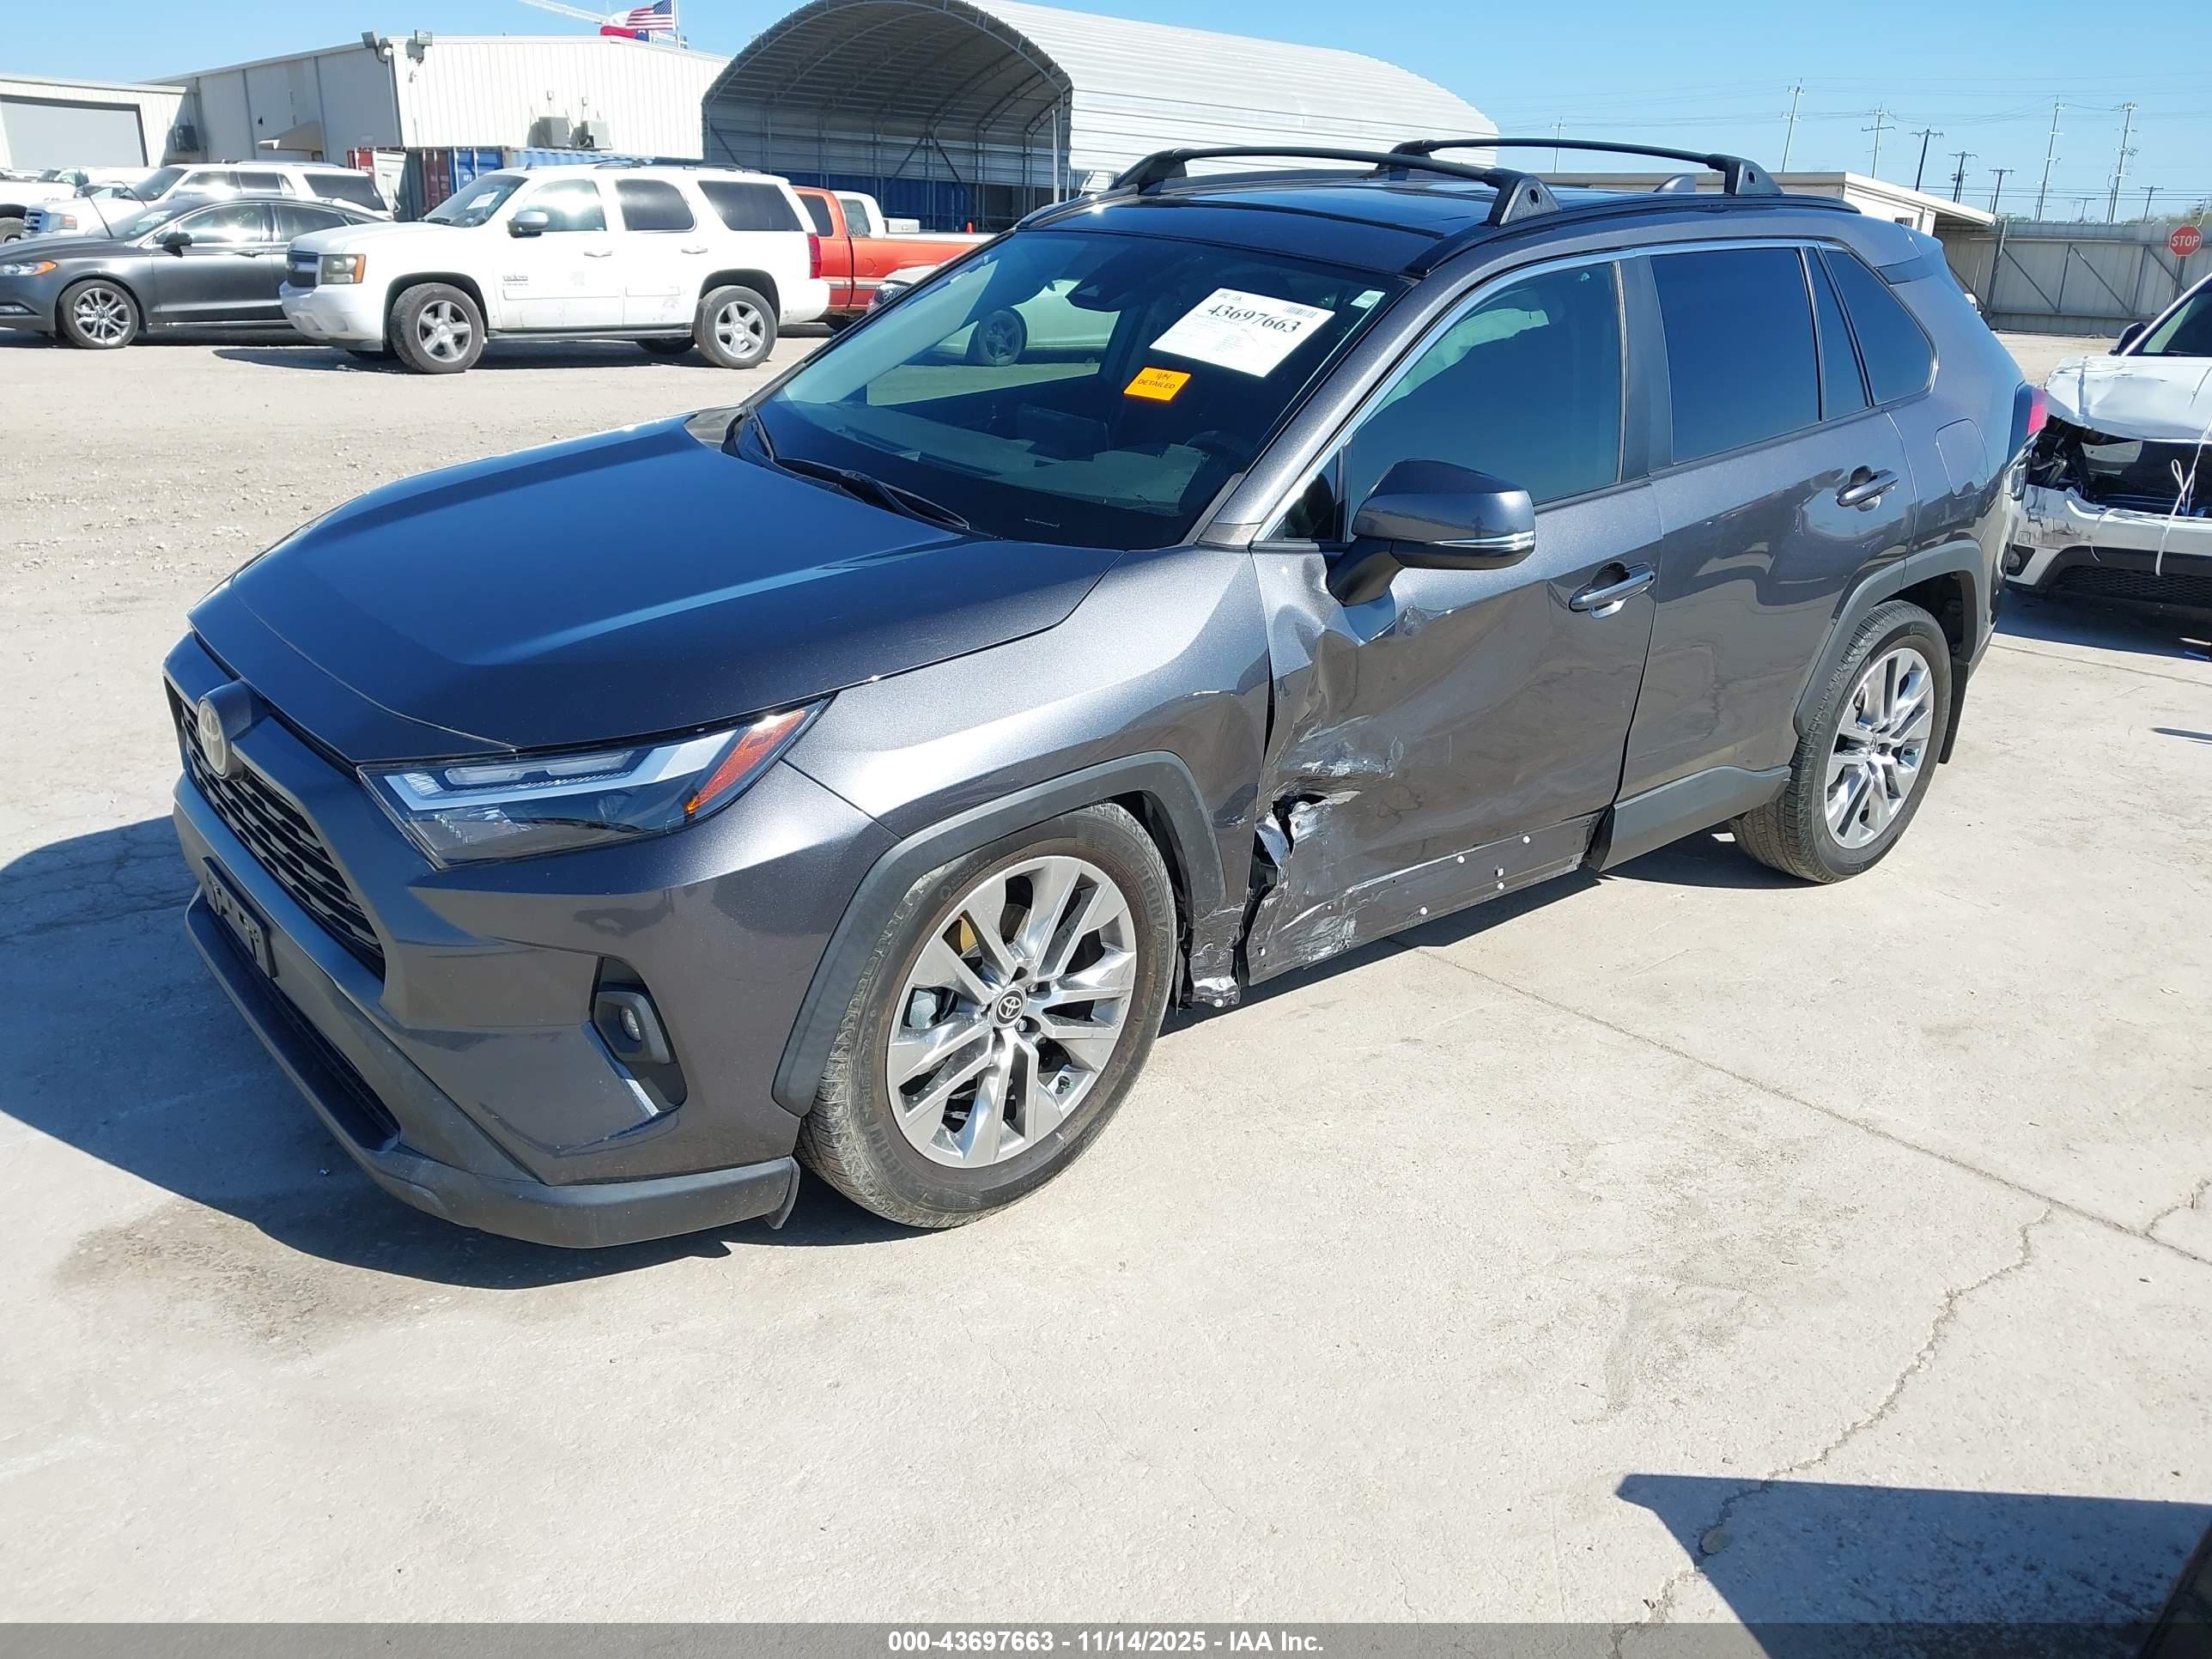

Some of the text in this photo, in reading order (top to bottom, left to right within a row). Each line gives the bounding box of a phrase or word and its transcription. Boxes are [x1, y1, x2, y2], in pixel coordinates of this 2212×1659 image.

[2172, 235, 2200, 247] STOP
[1206, 304, 1303, 334] 43697663
[1137, 379, 1176, 389] DETAILED
